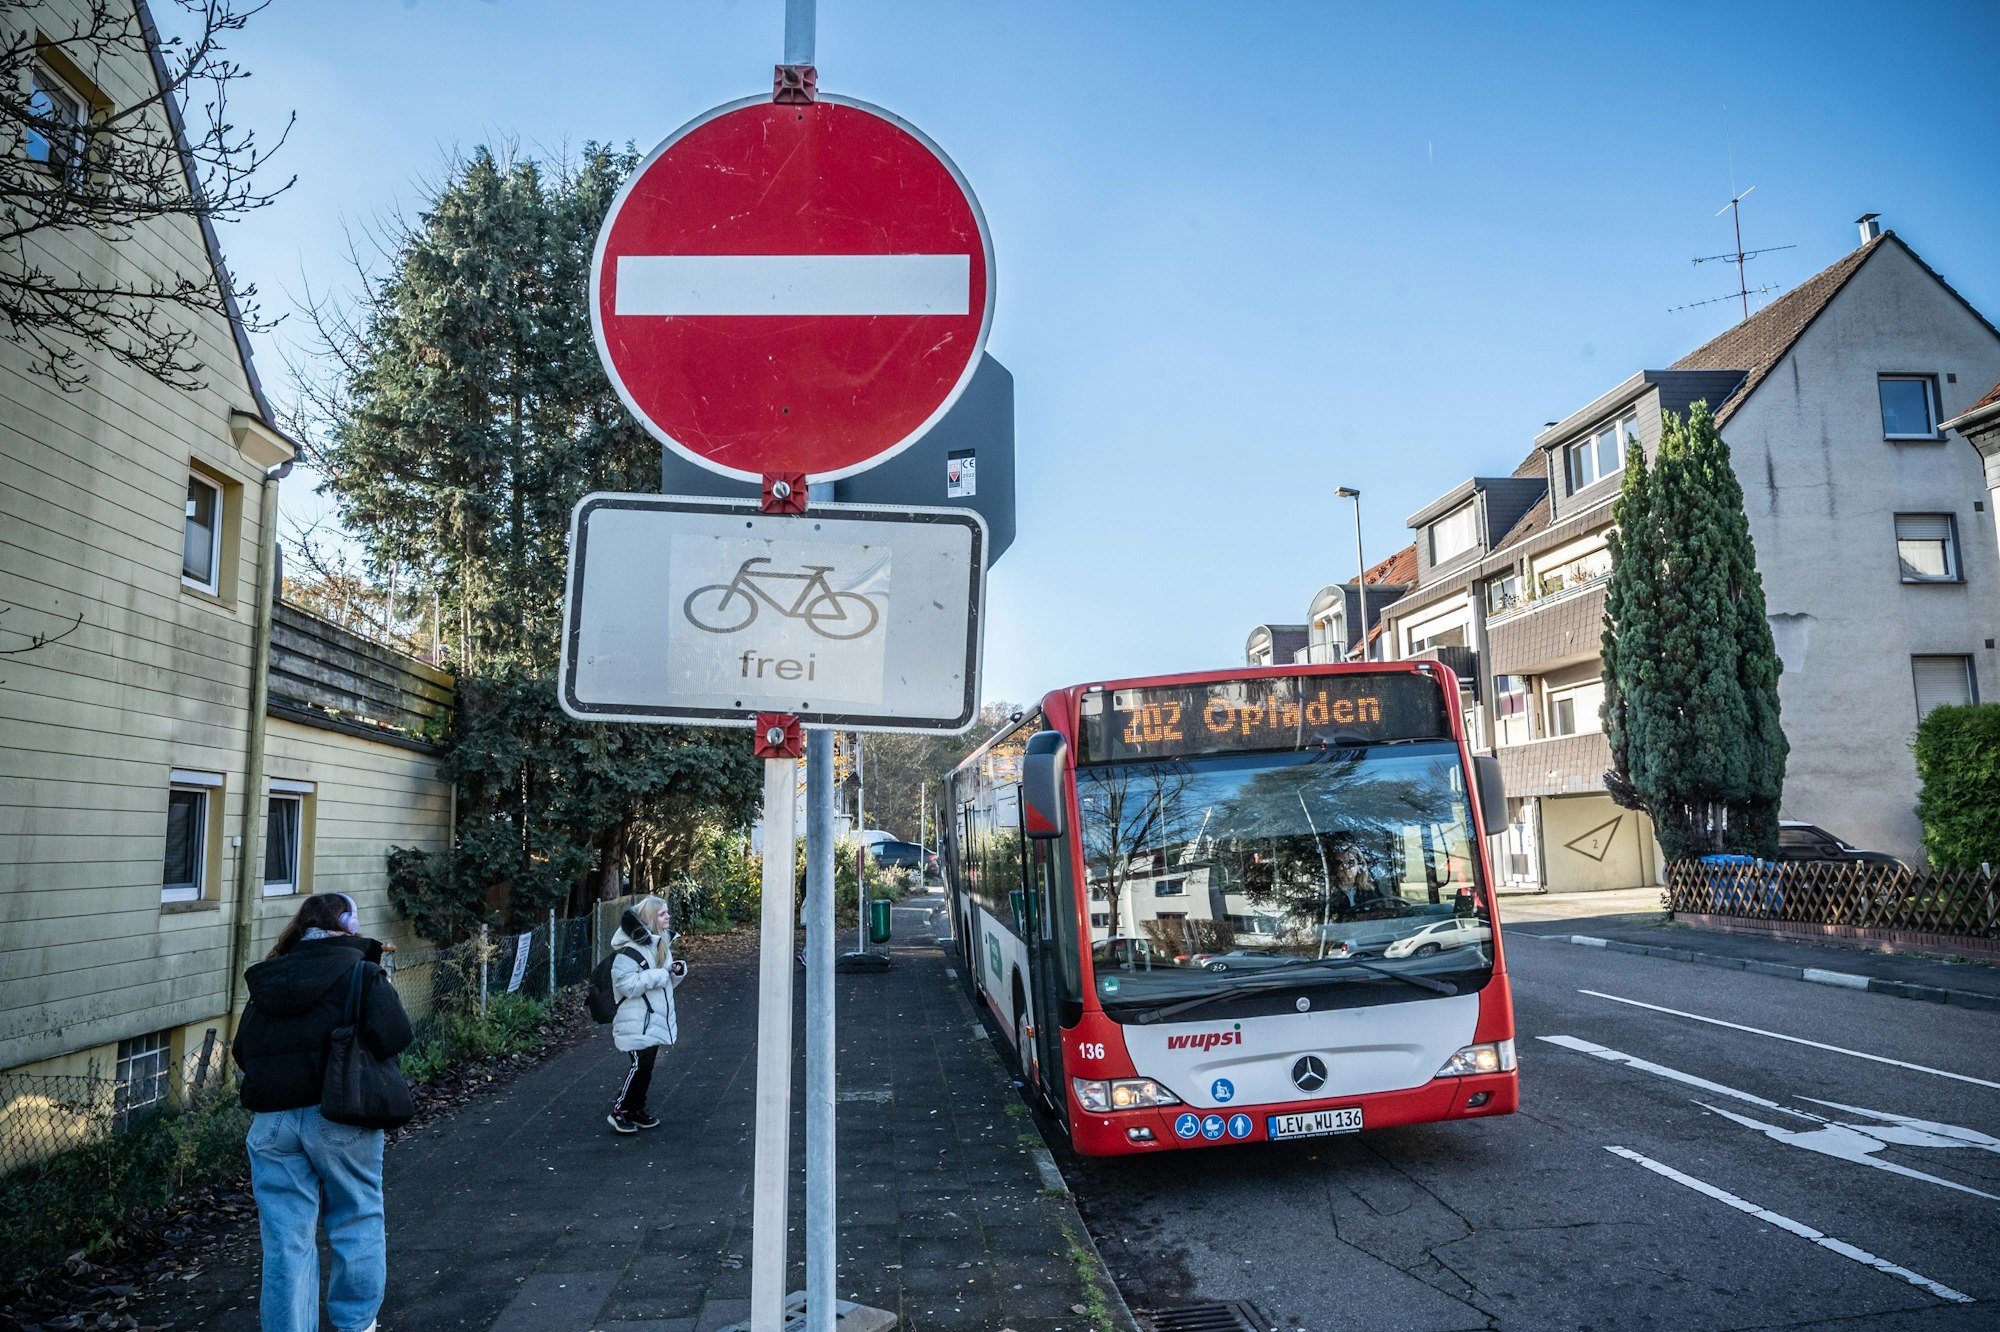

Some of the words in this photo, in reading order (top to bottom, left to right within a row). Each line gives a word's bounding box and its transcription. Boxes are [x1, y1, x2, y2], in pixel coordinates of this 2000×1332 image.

[738, 649, 816, 681] frei
[1122, 701, 1183, 743] 202
[1203, 691, 1380, 735] Opladen
[1592, 839, 1598, 849] 2
[1167, 1023, 1242, 1052] wupsi
[1078, 1042, 1105, 1060] 136
[1277, 1116, 1304, 1134] LEV
[1315, 1113, 1332, 1130] WU
[1335, 1110, 1361, 1128] 136
